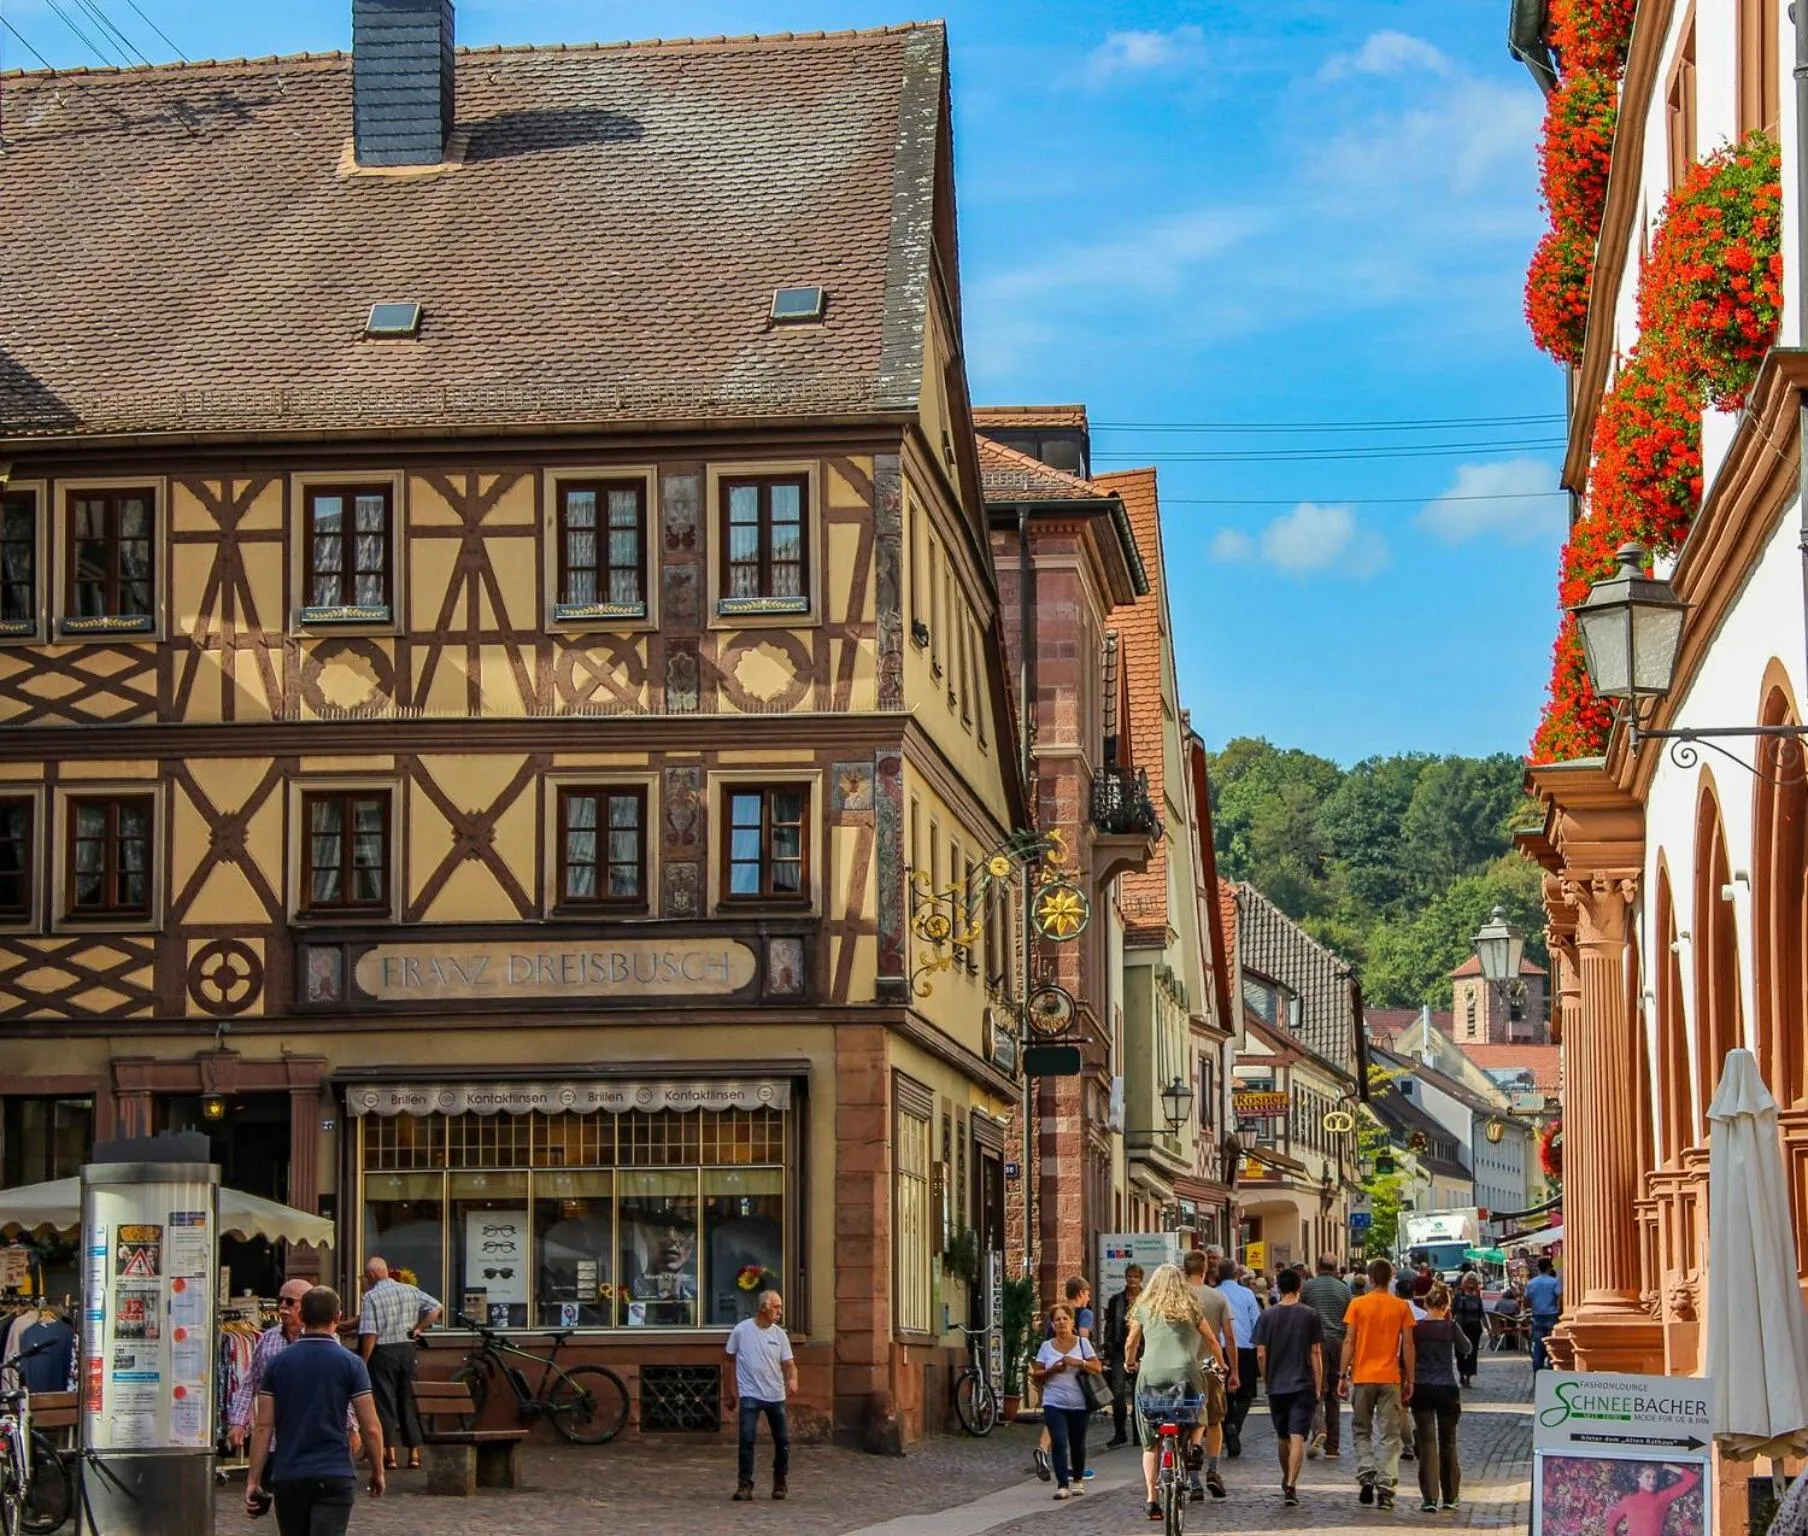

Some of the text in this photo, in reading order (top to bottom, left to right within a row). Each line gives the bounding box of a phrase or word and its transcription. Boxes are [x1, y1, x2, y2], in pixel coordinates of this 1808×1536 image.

[382, 951, 732, 987] FRANZ DREISBUSCH
[390, 1092, 548, 1106] Brillen Kontaktlinsen
[587, 1089, 746, 1103] Brillen Kontaktlinsen
[1579, 1380, 1649, 1393] FASHIONLOUNGE
[1540, 1381, 1708, 1428] SCHNEEBACHER
